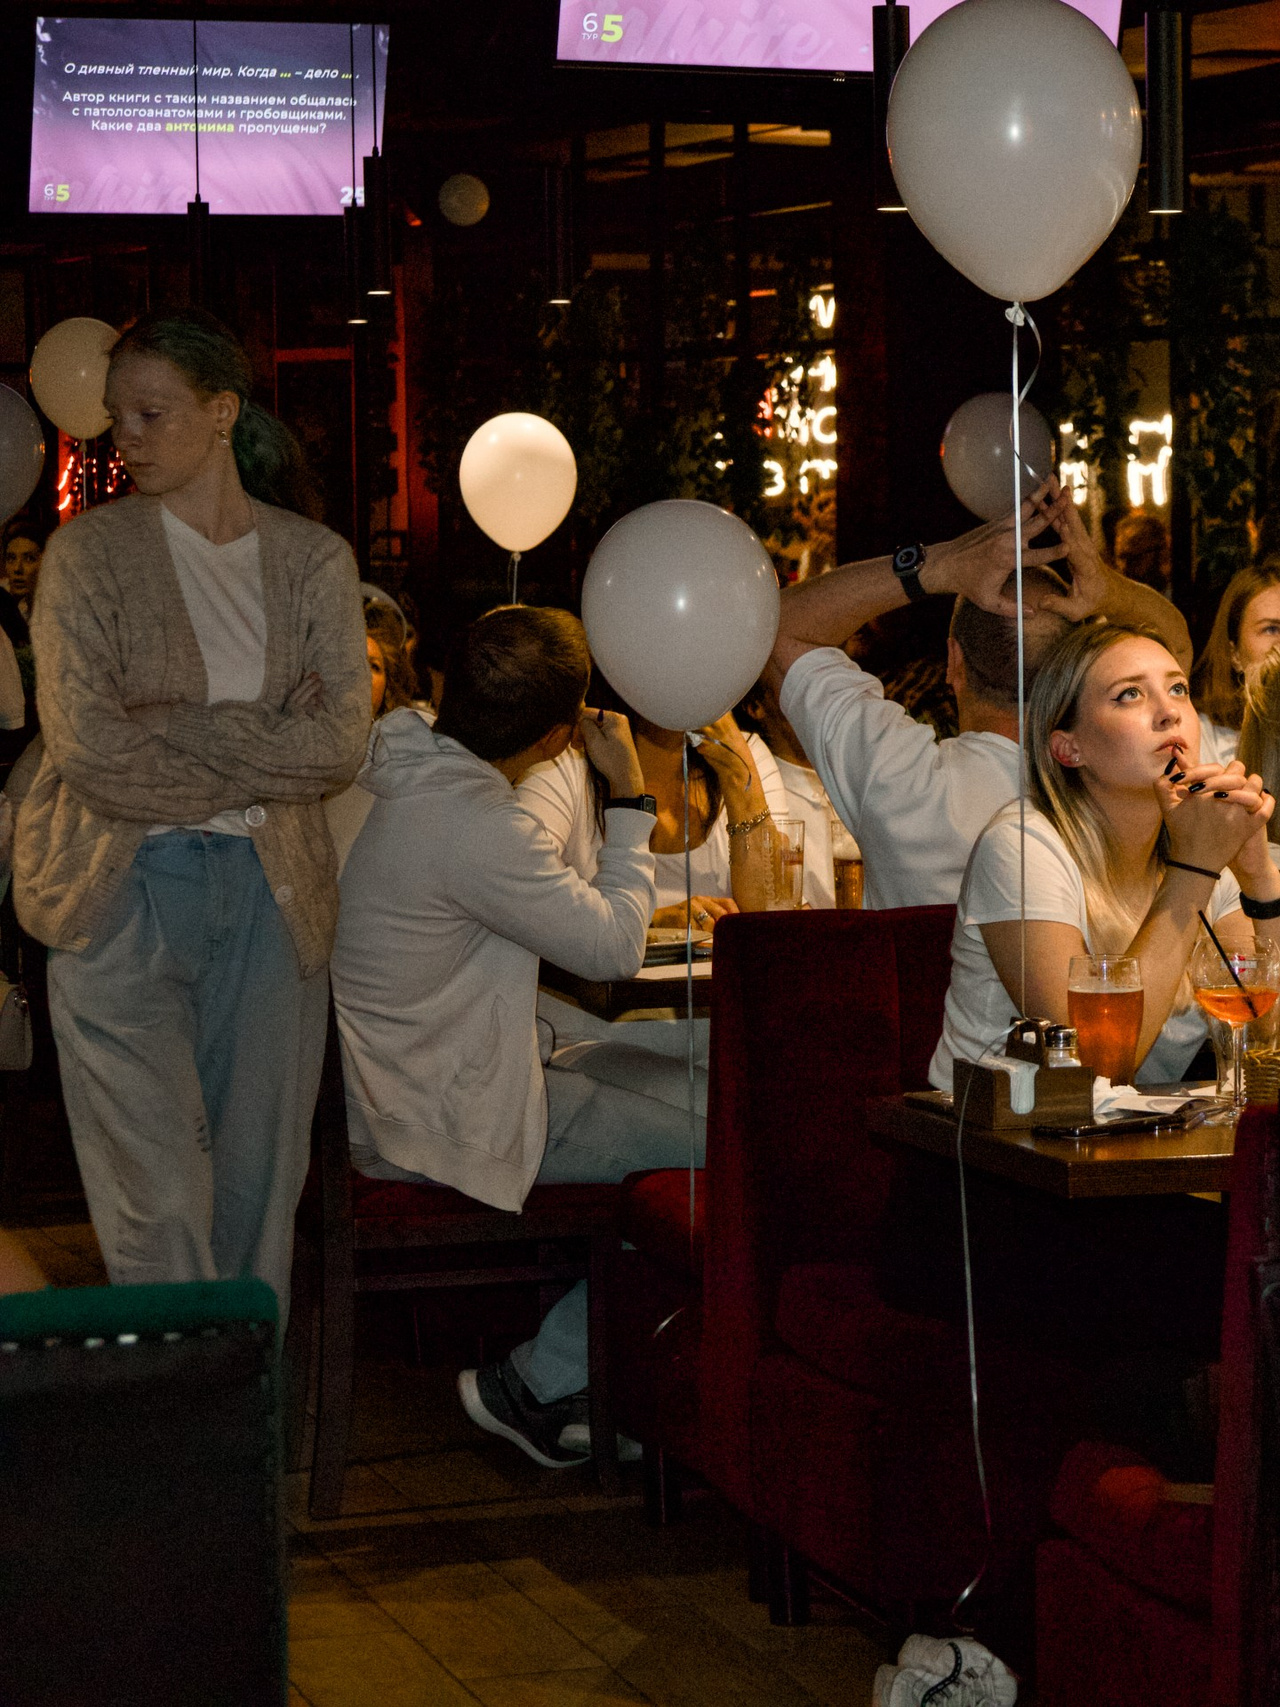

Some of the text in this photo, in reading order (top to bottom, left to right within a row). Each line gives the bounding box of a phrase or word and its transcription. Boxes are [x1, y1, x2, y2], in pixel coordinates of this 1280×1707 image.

[582, 13, 624, 42] 6 5
[64, 63, 76, 74] О
[78, 63, 134, 75] дивный
[138, 65, 199, 76] тленный
[202, 67, 234, 78] мир.
[238, 66, 278, 79] Когда
[304, 69, 339, 79] дело
[62, 91, 357, 107] Автор книги с таким названием общалась
[72, 107, 347, 120] с патологоанатомами и гробовщиками.
[91, 120, 327, 135] Какие два антонима пропущены?
[44, 183, 70, 202] 6 5
